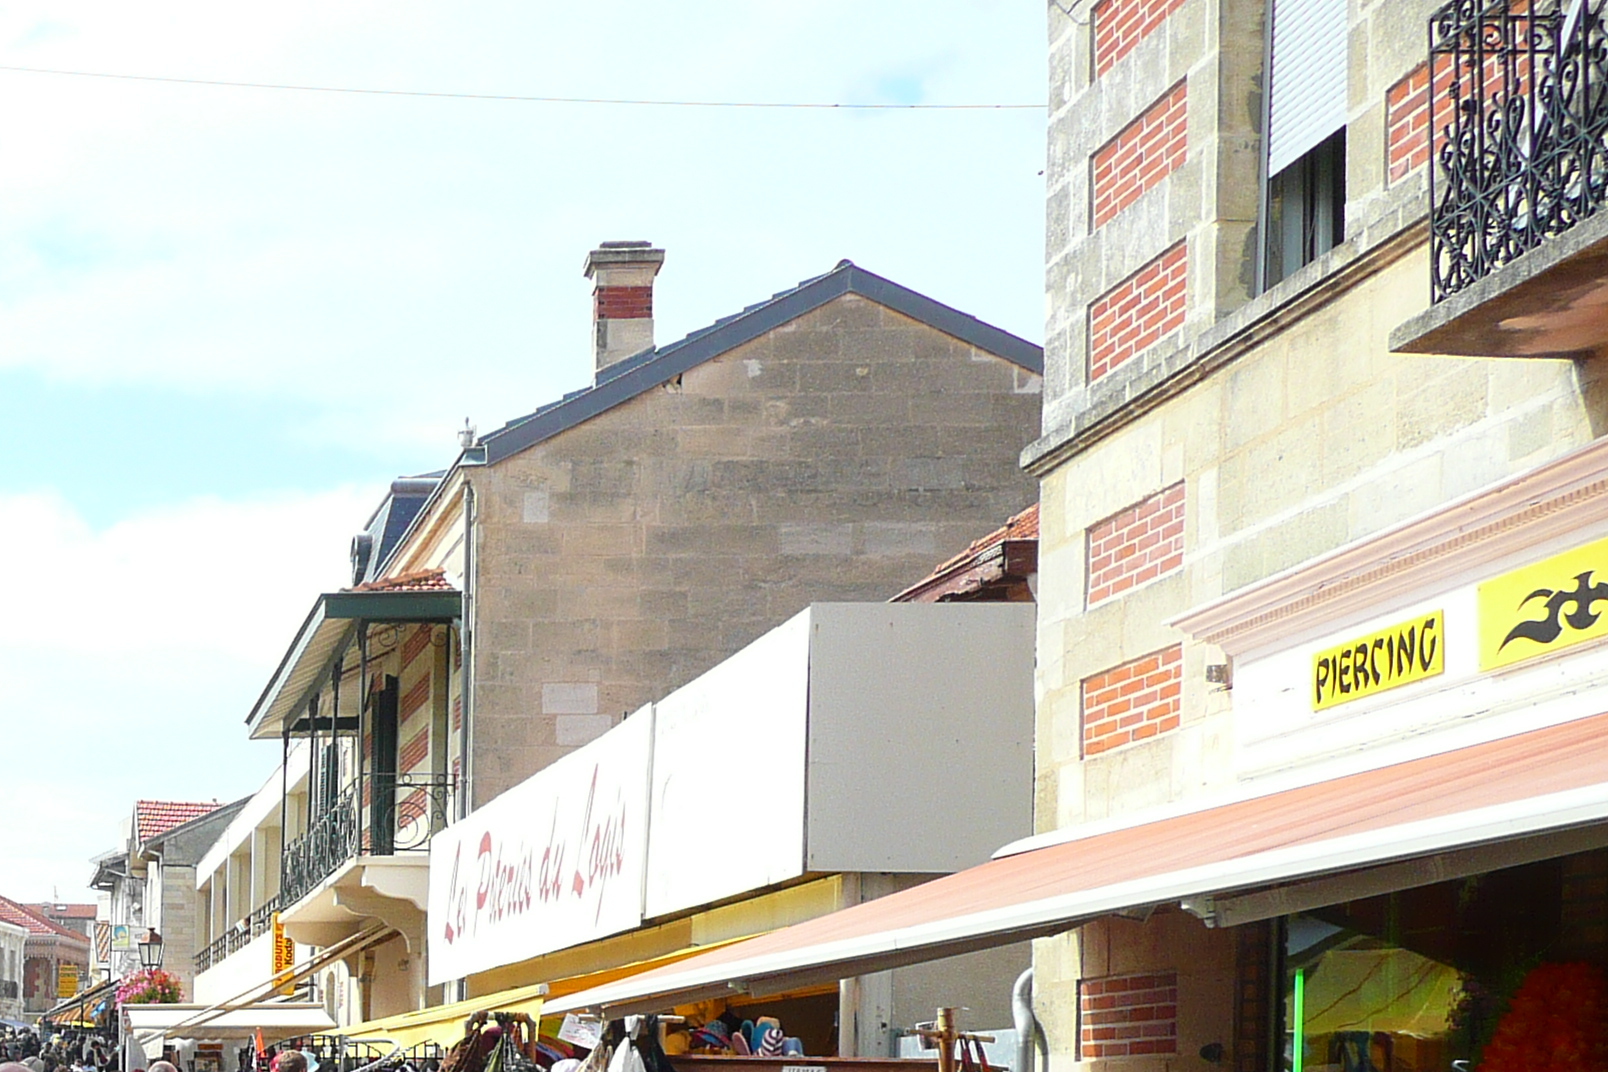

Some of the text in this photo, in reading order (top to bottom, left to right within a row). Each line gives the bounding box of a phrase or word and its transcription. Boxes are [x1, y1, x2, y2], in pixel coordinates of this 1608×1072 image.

[1315, 616, 1436, 704] PIERCING
[539, 796, 567, 903] du
[570, 762, 626, 928] Logis
